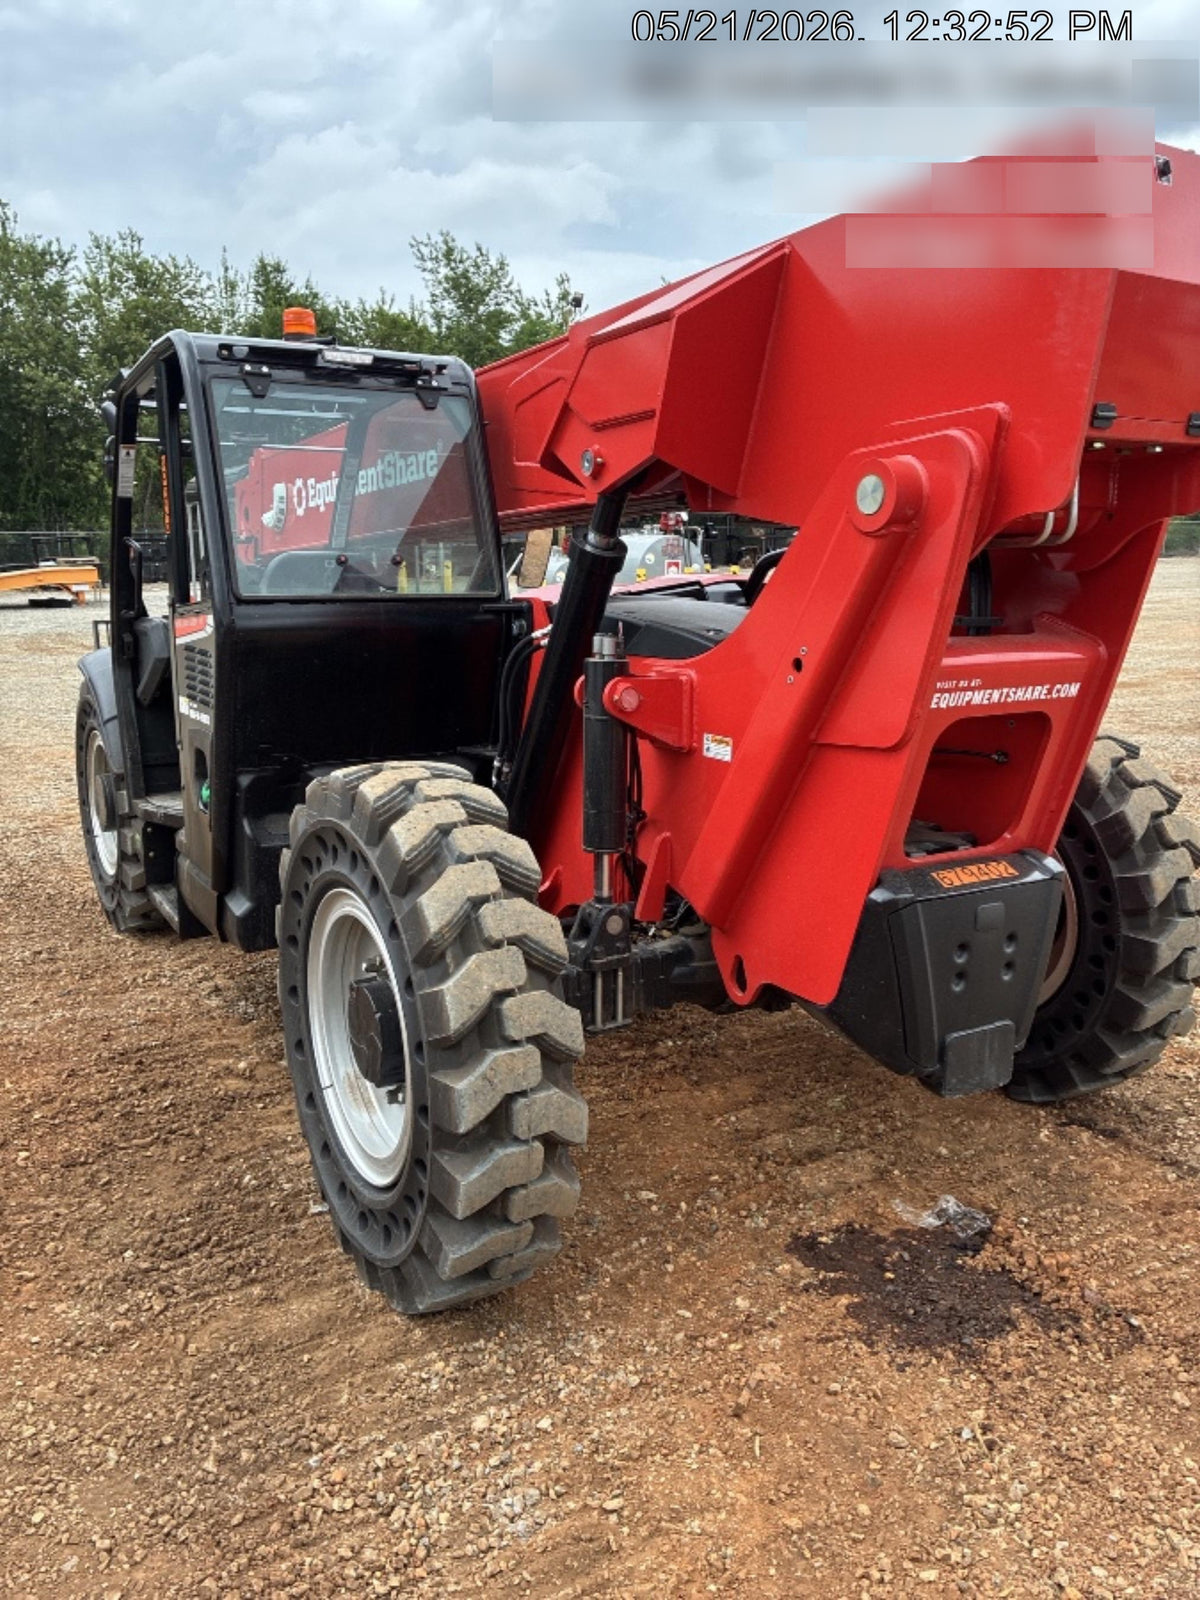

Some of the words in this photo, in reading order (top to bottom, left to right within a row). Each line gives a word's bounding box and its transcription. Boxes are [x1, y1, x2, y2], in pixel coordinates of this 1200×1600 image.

[307, 449, 438, 512] EquientShare
[930, 682, 1081, 709] EQUIPMENTSHARE.COM
[935, 861, 1014, 886] 679402
